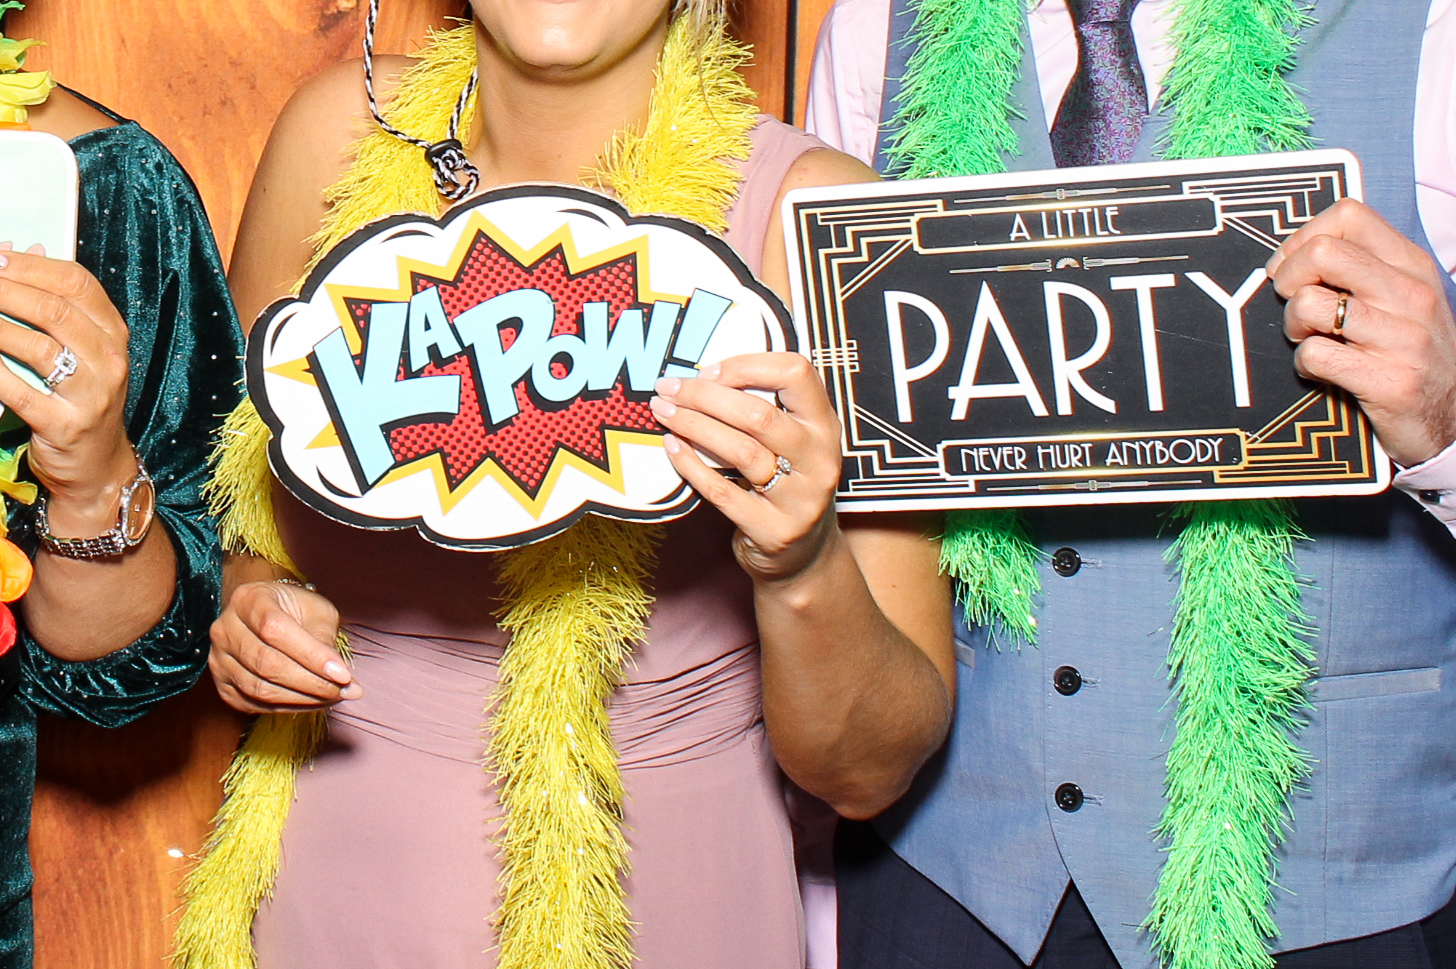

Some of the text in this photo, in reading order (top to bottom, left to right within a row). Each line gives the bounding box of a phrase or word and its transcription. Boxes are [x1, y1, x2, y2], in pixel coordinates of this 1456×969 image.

[1009, 206, 1122, 241] A LITTLE
[883, 266, 1268, 423] PARTY
[960, 437, 1224, 472] NEVER HURT ANYBODY
